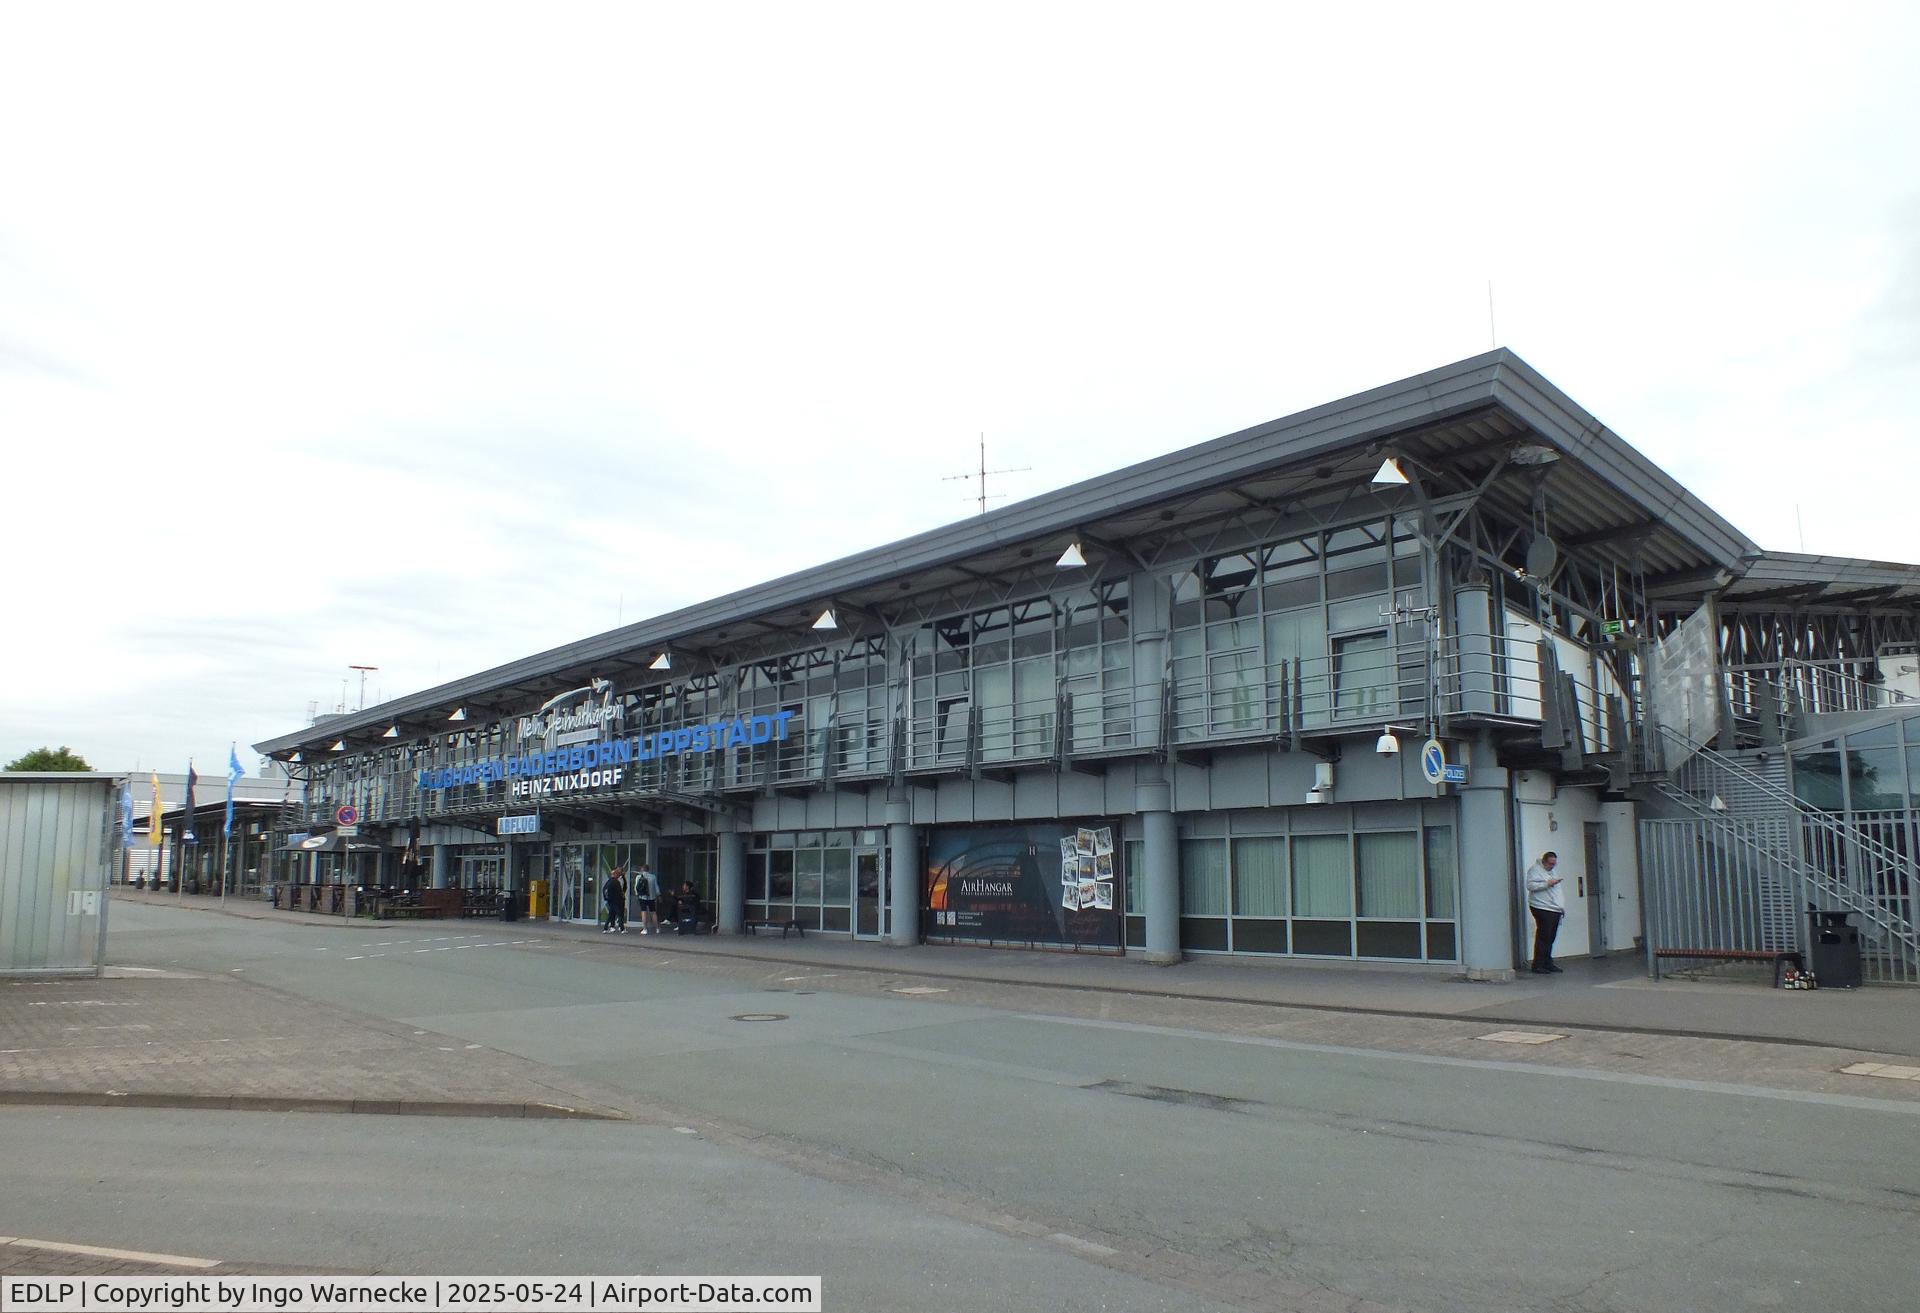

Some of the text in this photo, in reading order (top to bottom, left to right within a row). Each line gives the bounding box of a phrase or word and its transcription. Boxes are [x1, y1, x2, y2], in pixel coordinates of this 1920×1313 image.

[518, 716, 544, 743] Mein
[508, 739, 633, 779] PADERBORN
[638, 710, 795, 760] LIPPSTADT
[512, 768, 623, 796] HEINZ NIXDORF
